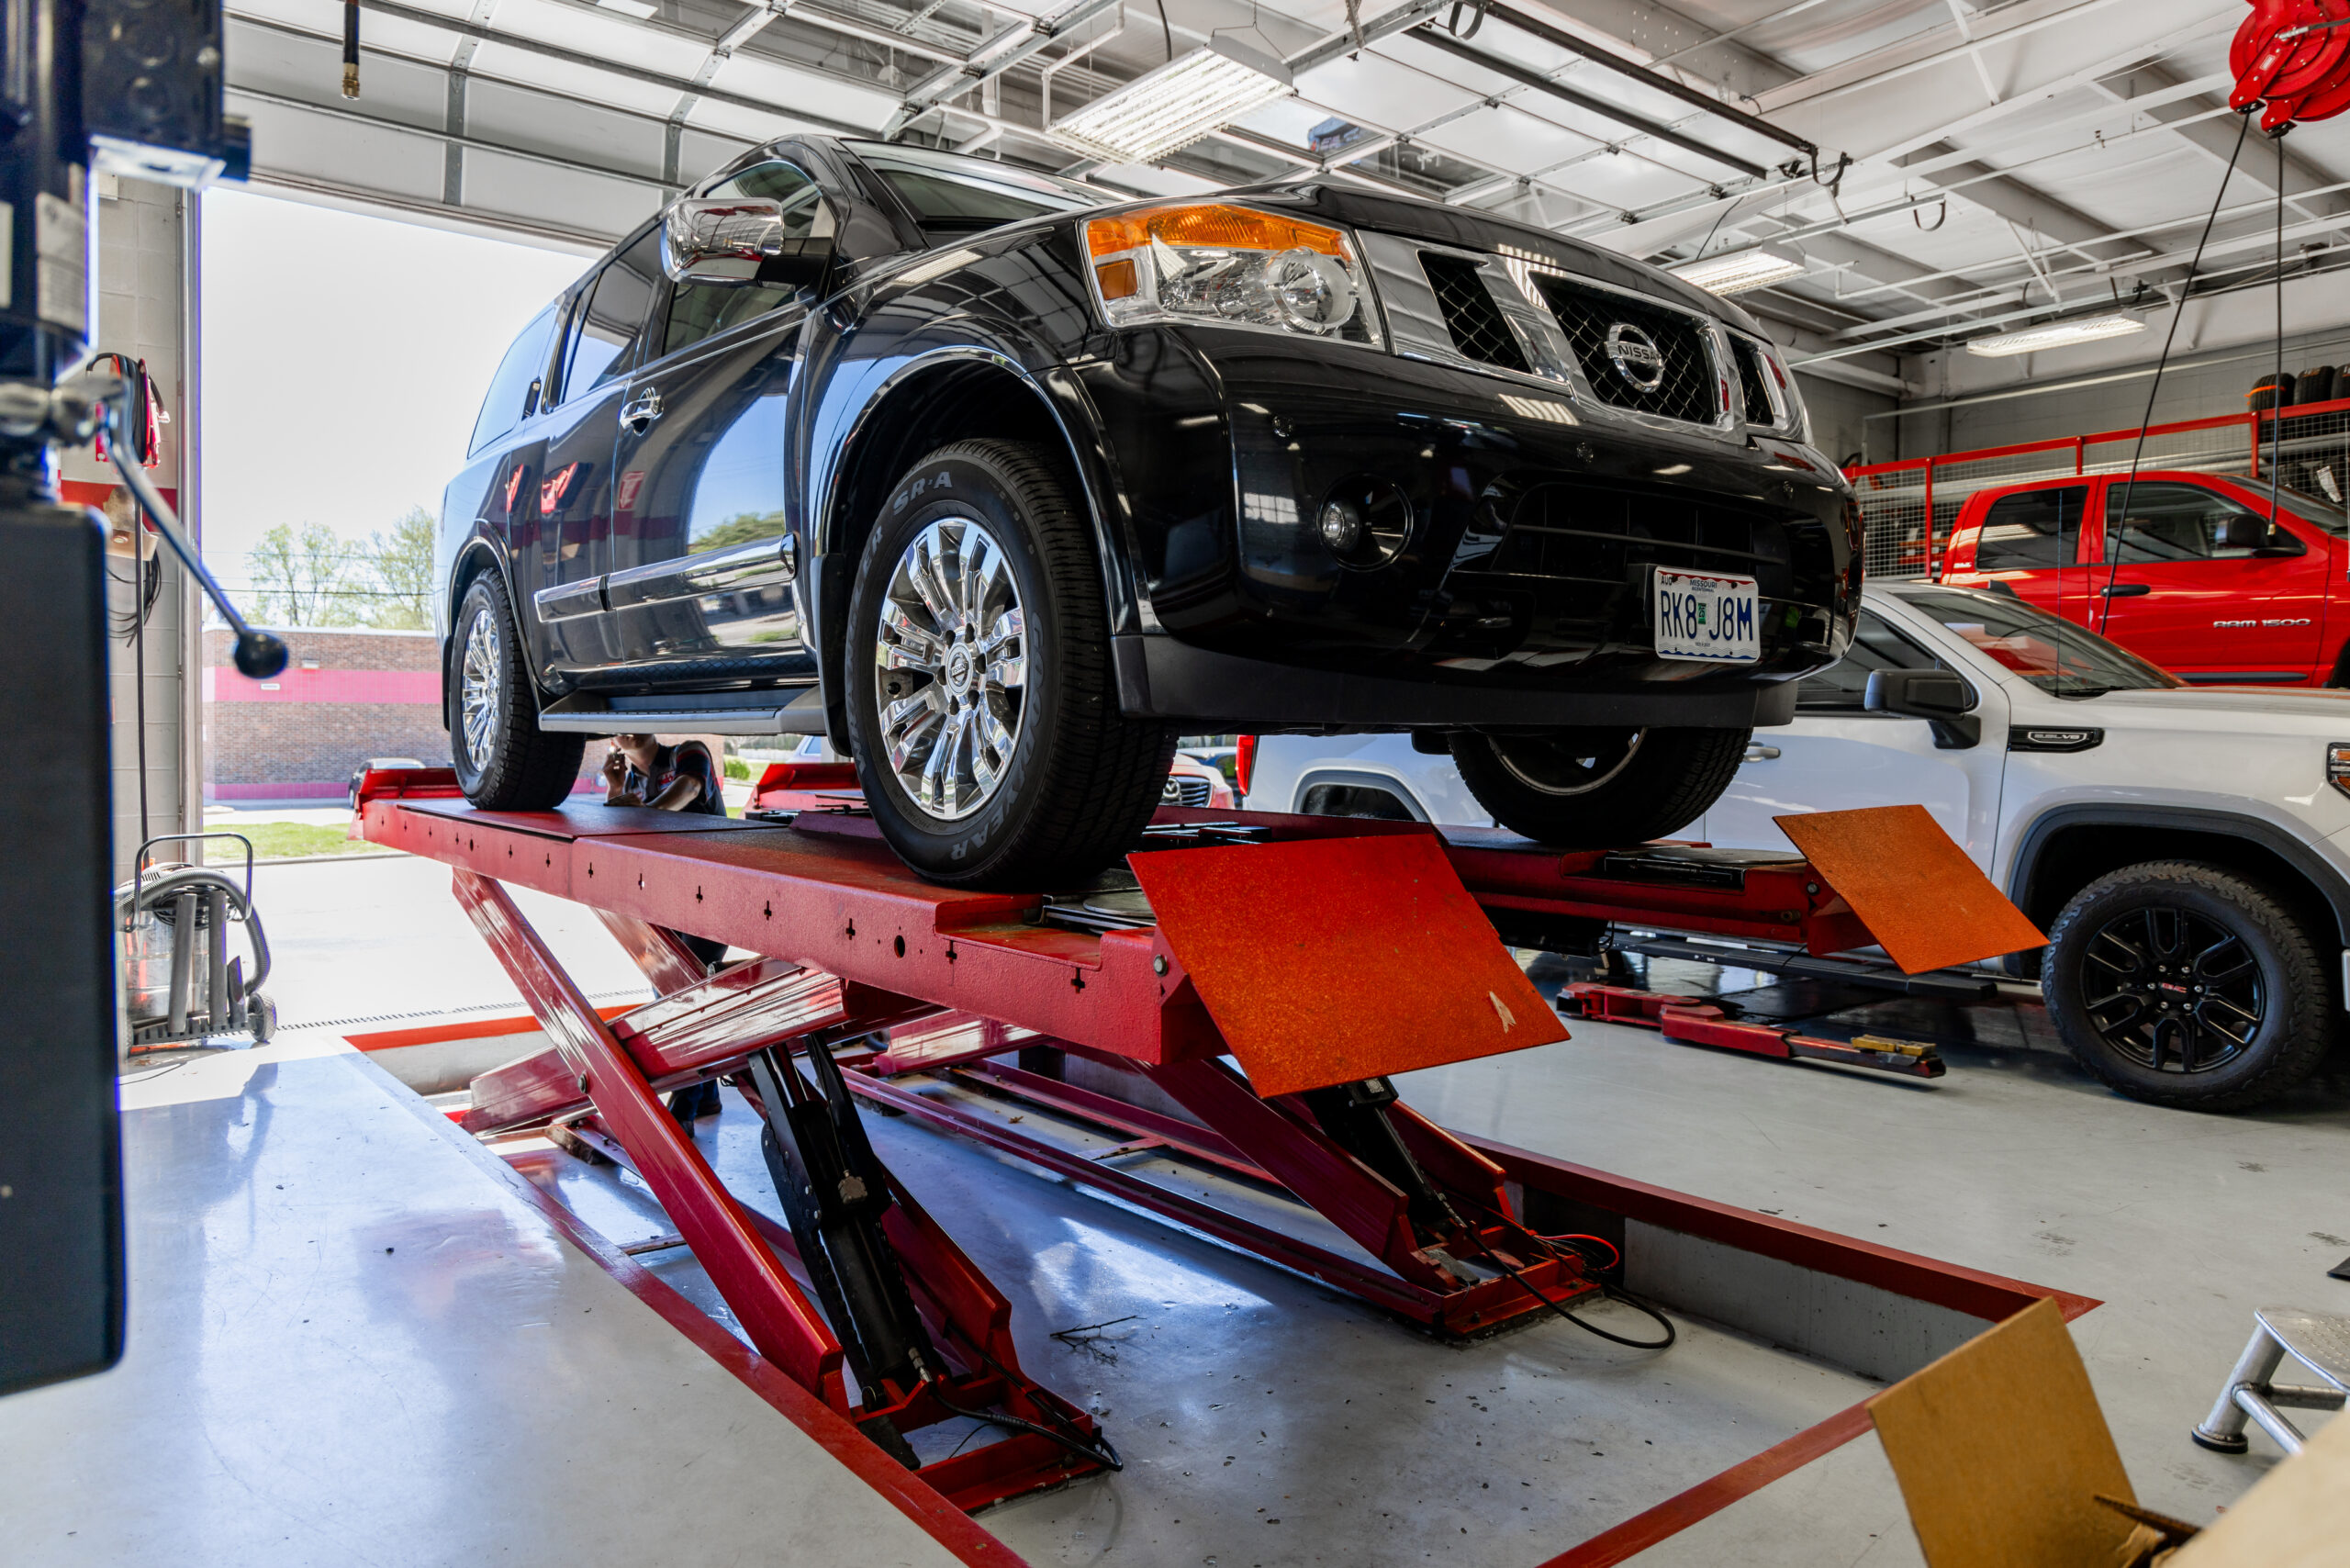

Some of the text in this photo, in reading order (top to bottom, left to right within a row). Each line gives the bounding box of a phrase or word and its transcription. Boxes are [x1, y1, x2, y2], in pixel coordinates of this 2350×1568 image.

[1617, 345, 1659, 361] NISSA
[1690, 579, 1718, 588] MISSOURI
[1661, 590, 1697, 639] RK8
[1708, 597, 1753, 641] J8M
[2213, 618, 2311, 628] RAM 1500
[951, 611, 1044, 860] GOODYEAR
